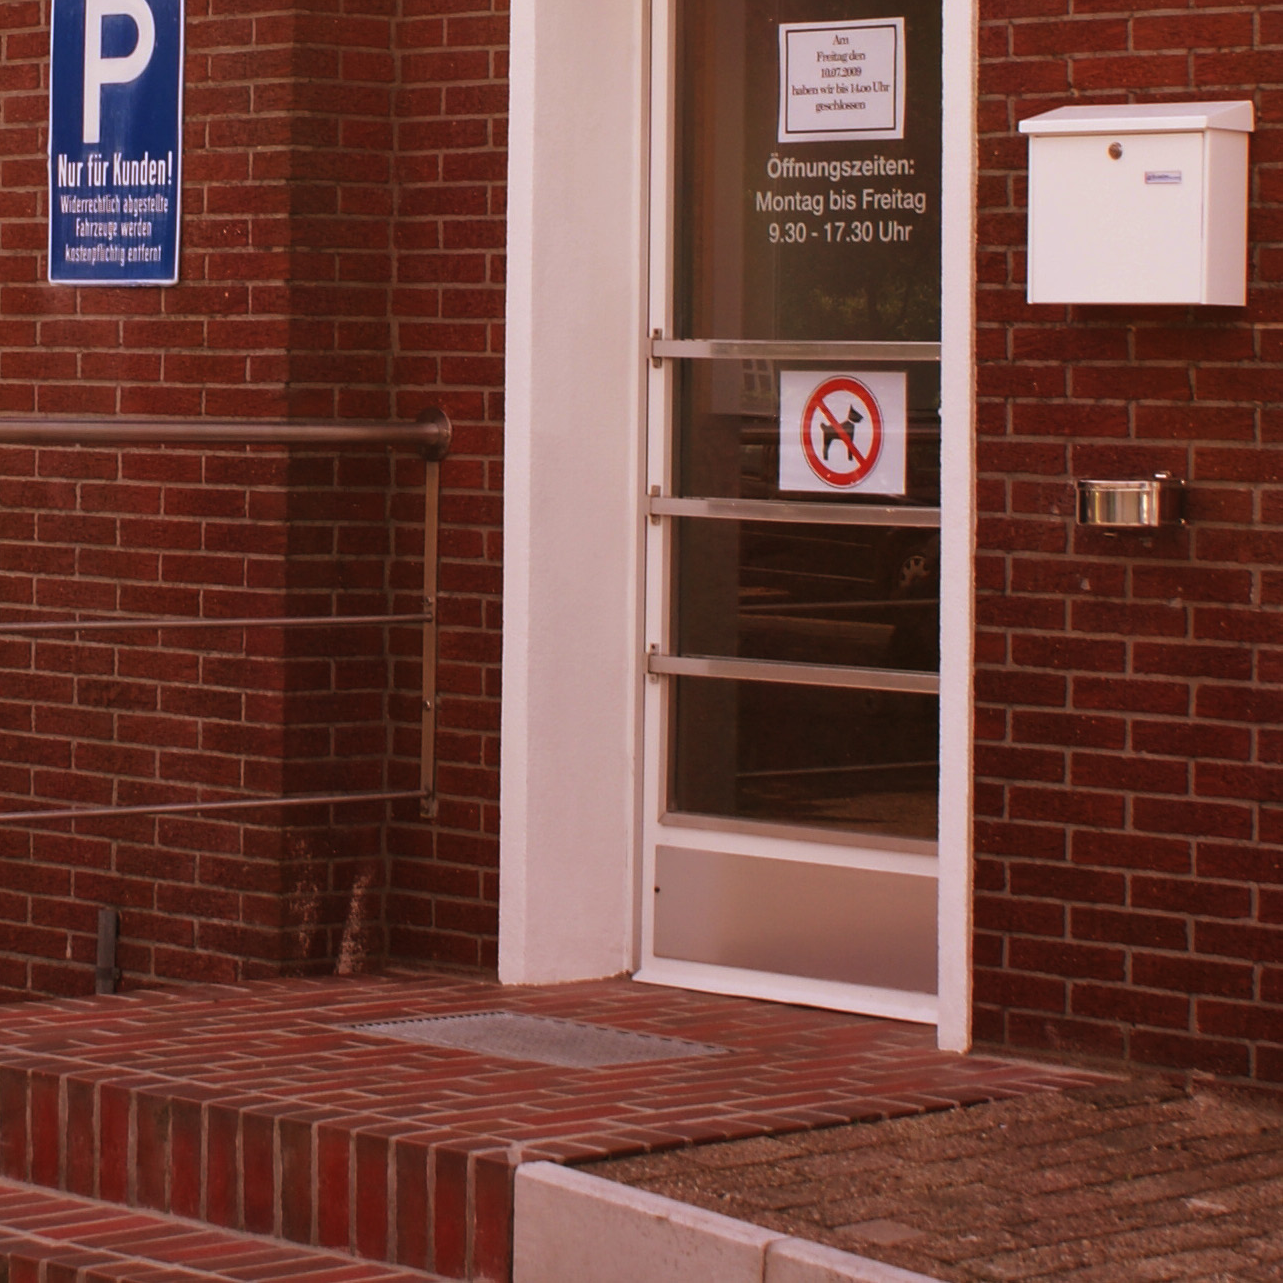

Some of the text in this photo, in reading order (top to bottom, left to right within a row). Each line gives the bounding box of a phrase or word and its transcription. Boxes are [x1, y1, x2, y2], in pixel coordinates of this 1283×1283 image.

[832, 34, 849, 46] Am
[816, 50, 866, 63] Freitag den
[791, 84, 818, 96] haben
[819, 84, 834, 94] wir
[835, 82, 849, 94] bis
[872, 81, 890, 93] Uhr
[815, 100, 866, 114] geschlossen
[58, 150, 173, 188] Nur für Kunden!
[767, 152, 915, 182] Öffnungszeiten:
[60, 193, 169, 218] Widerrechtlich abgestellte
[755, 188, 927, 216] Montag bis Freitag
[75, 217, 152, 241] Fahrzeuge werden
[768, 221, 808, 244] 9.30
[823, 220, 873, 243] 17.30
[878, 220, 913, 243] Uhr
[64, 243, 162, 267] kostenpflichtig entfernt
